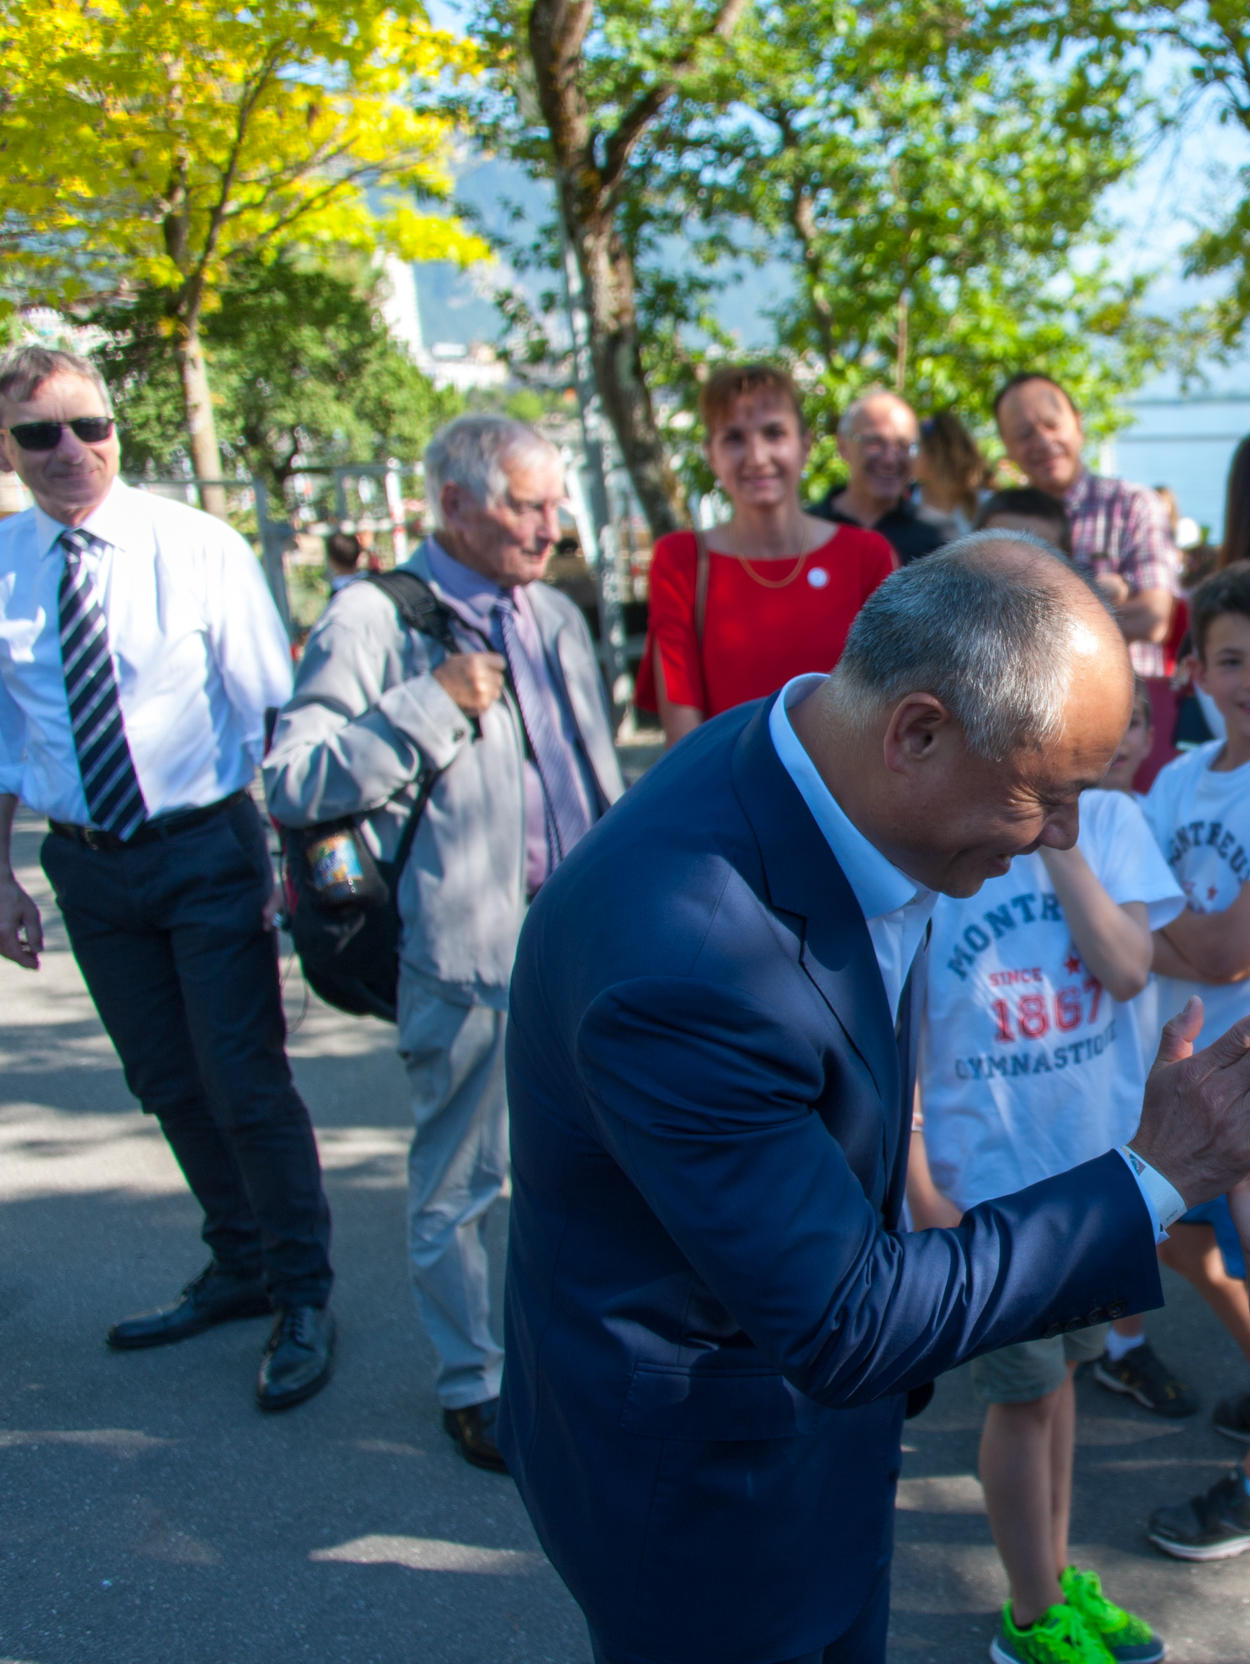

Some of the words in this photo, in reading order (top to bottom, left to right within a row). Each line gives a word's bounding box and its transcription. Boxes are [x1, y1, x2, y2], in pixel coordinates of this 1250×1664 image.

[947, 893, 1064, 982] MONTR
[989, 967, 1043, 988] SINCE
[991, 974, 1104, 1045] 1867
